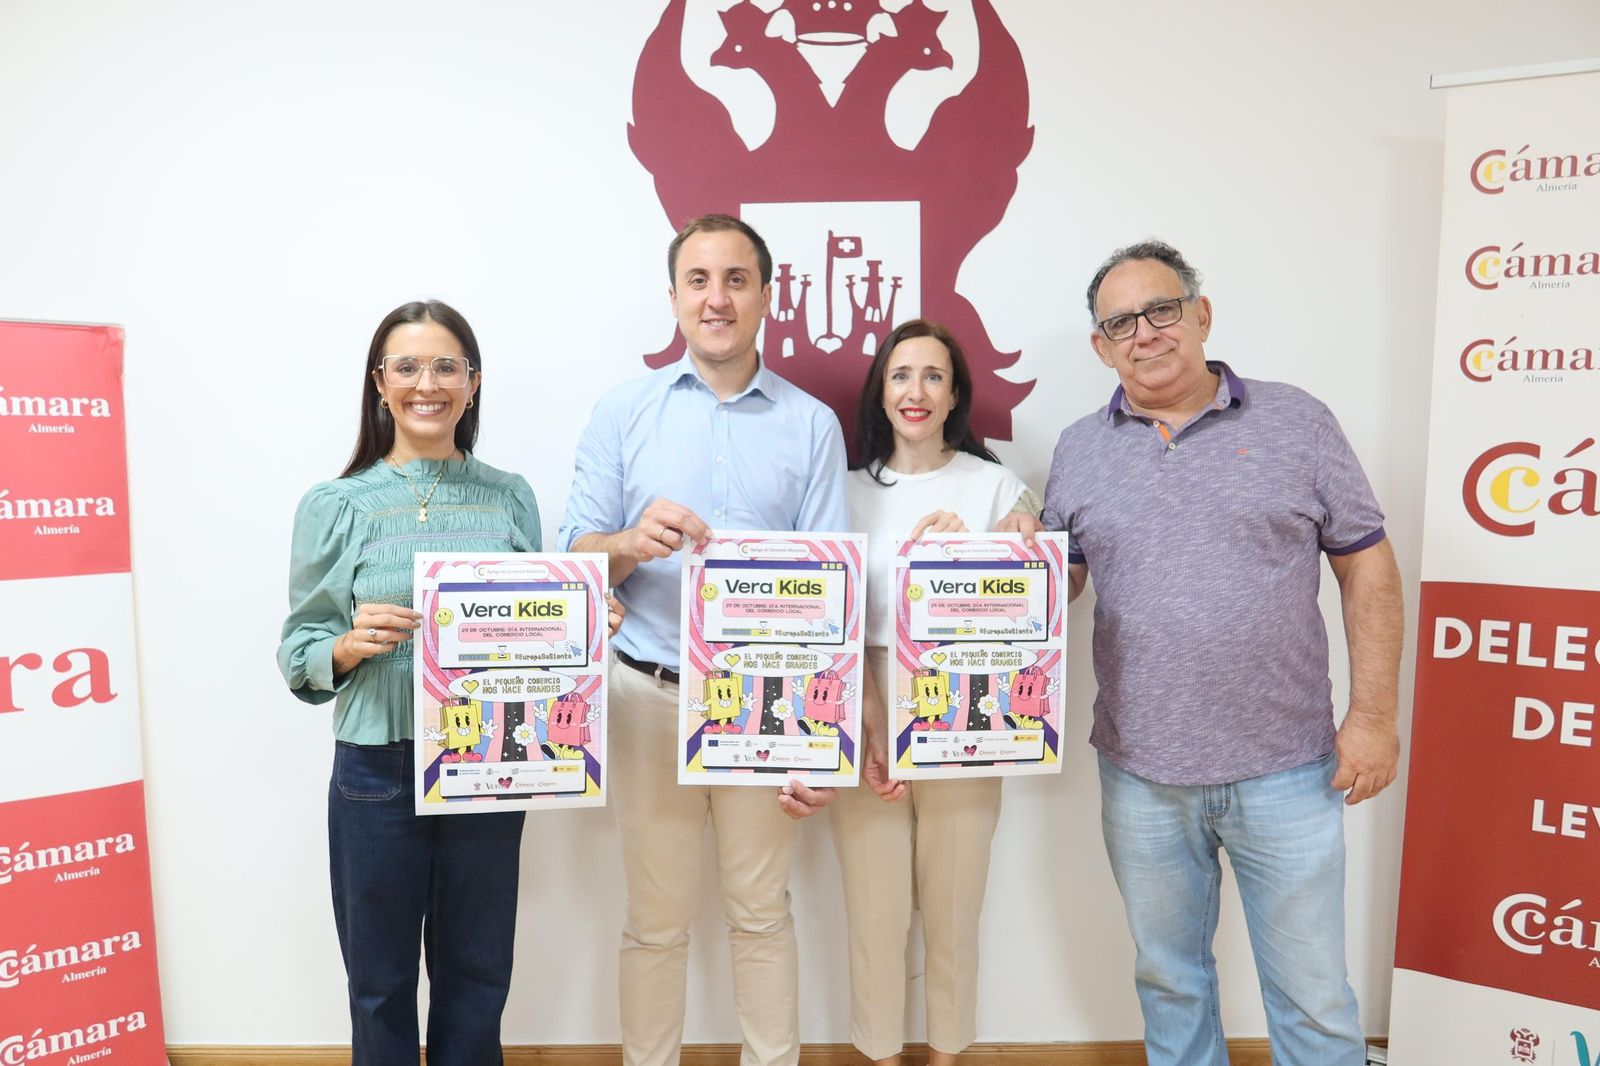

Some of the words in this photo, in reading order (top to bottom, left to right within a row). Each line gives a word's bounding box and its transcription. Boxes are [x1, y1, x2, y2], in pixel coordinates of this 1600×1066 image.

[1529, 279, 1570, 290] Almería
[28, 423, 75, 433] Almería
[34, 524, 80, 535] Almería
[726, 579, 772, 594] Vera
[780, 579, 822, 595] Kids
[930, 580, 976, 594] Vera
[982, 579, 1025, 594] Kids
[460, 602, 511, 618] Vera
[518, 600, 564, 618] Kids
[1433, 616, 1600, 671] DELE
[756, 652, 783, 661] PEQUEÑO
[961, 650, 988, 660] PEQUEÑO
[744, 660, 758, 668] NOS
[762, 660, 780, 668] HACE
[786, 661, 818, 670] GRANDES
[495, 676, 524, 686] PEQUEÑO
[482, 686, 498, 694] NOS
[502, 686, 522, 694] HACE
[527, 685, 560, 693] GRANDES
[1512, 696, 1595, 747] DE
[54, 866, 101, 883] Almería
[61, 965, 107, 984] Almería
[67, 1046, 112, 1066] Almería
